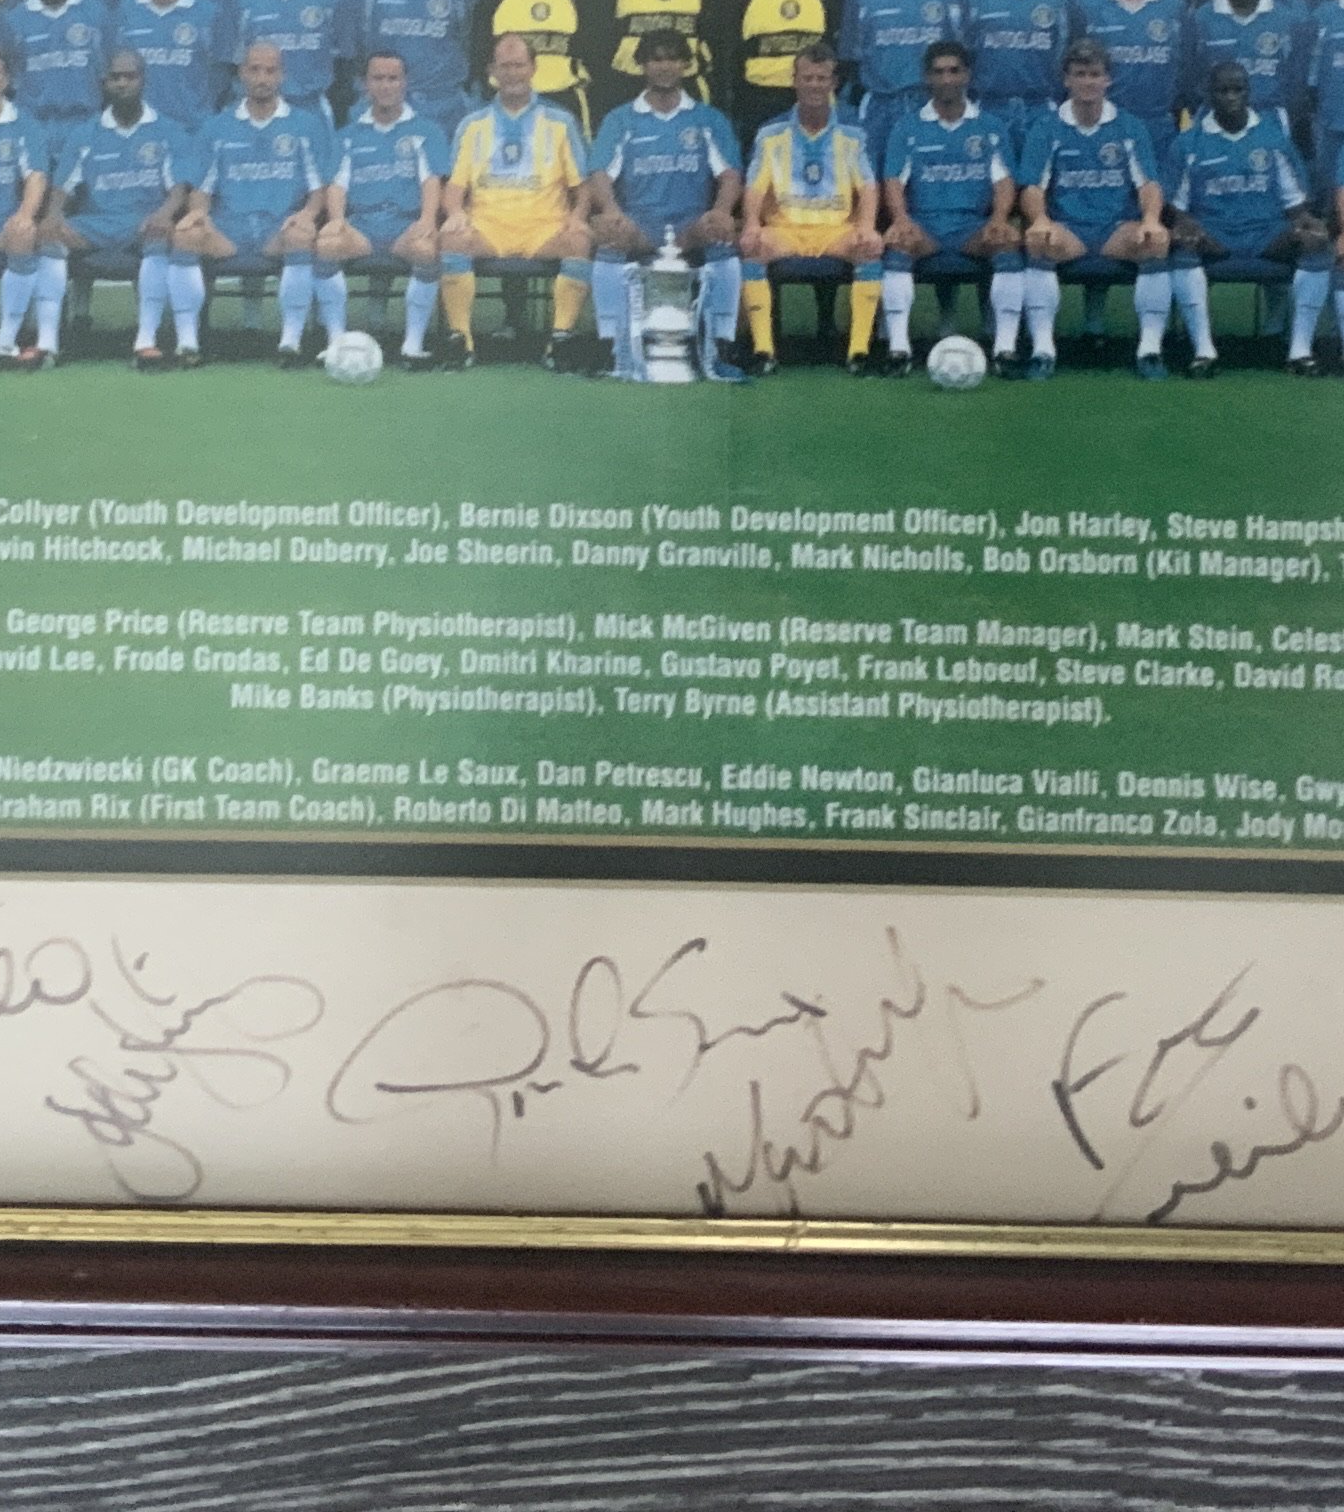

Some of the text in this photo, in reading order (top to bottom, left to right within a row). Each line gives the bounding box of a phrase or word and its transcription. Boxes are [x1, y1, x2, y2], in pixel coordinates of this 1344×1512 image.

[88, 499, 168, 531] (Youth
[176, 500, 340, 535] Development
[348, 501, 449, 534] Officer),
[459, 502, 540, 530] Bernie
[641, 504, 721, 537] (Youth
[730, 505, 896, 542] Development
[902, 508, 1006, 541] Officer),
[1014, 509, 1061, 537] Jon
[1067, 510, 1158, 546] Harley,
[1167, 512, 1239, 541] Steve
[44, 536, 171, 568] Hitchcock,
[182, 537, 281, 564] Michael
[290, 537, 394, 572] Duberry,
[404, 538, 448, 565] Joe
[457, 538, 562, 571] Sheerin,
[571, 539, 651, 574] Danny
[657, 541, 781, 575] Granville,
[790, 543, 855, 571] Mark
[982, 546, 1032, 574] Bob
[1145, 549, 1192, 582] (Kit
[1198, 550, 1330, 585] Manager),
[6, 609, 96, 643] George
[105, 610, 169, 637] Price
[177, 611, 289, 643] (Reserve
[298, 612, 365, 639] Team
[373, 612, 583, 646] Physiotherapist),
[594, 614, 655, 642] Mick
[778, 617, 893, 650] (Reserve
[898, 619, 969, 647] Team
[975, 620, 1107, 654] Manager),
[1115, 623, 1181, 651] Mark
[1187, 624, 1263, 658] Stein,
[50, 646, 103, 677] Lee,
[114, 646, 184, 673] Frode
[299, 648, 329, 674] Ed
[339, 648, 372, 674] De
[380, 649, 449, 682] Goey,
[460, 650, 537, 675] Dmitri
[660, 652, 762, 679] Gustavo
[769, 654, 849, 687] Poyet,
[857, 655, 929, 682] Frank
[1055, 658, 1127, 686] Steve
[1133, 660, 1225, 693] Clarke,
[1233, 662, 1307, 690] David
[231, 683, 1111, 727] Mike Banks (Physiotherapist), Terry Byrne (Assistant Physiotherapist).
[151, 756, 197, 788] (GK
[207, 757, 301, 789] Coach),
[312, 758, 410, 785] Graeme
[418, 759, 449, 785] Le
[457, 759, 527, 791] Saux,
[537, 760, 587, 787] Dan
[594, 761, 711, 794] Petrescu,
[720, 763, 793, 790] Eddie
[799, 764, 903, 797] Newton,
[911, 766, 1024, 794] Gianluca
[1116, 771, 1206, 799] Dennis
[1213, 773, 1286, 805] Wise,
[90, 794, 131, 820] Rix
[139, 794, 206, 826] (First
[213, 795, 281, 822] Team
[288, 795, 383, 827] Coach),
[393, 796, 492, 823] Roberto
[500, 797, 528, 824] Di
[535, 797, 631, 830] Matteo,
[640, 799, 705, 827] Mark
[710, 800, 817, 836] Hughes,
[824, 802, 897, 830] Frank
[1016, 806, 1155, 835] Gianfranco
[1161, 810, 1227, 842] Zola,
[1235, 811, 1296, 846] Jody
